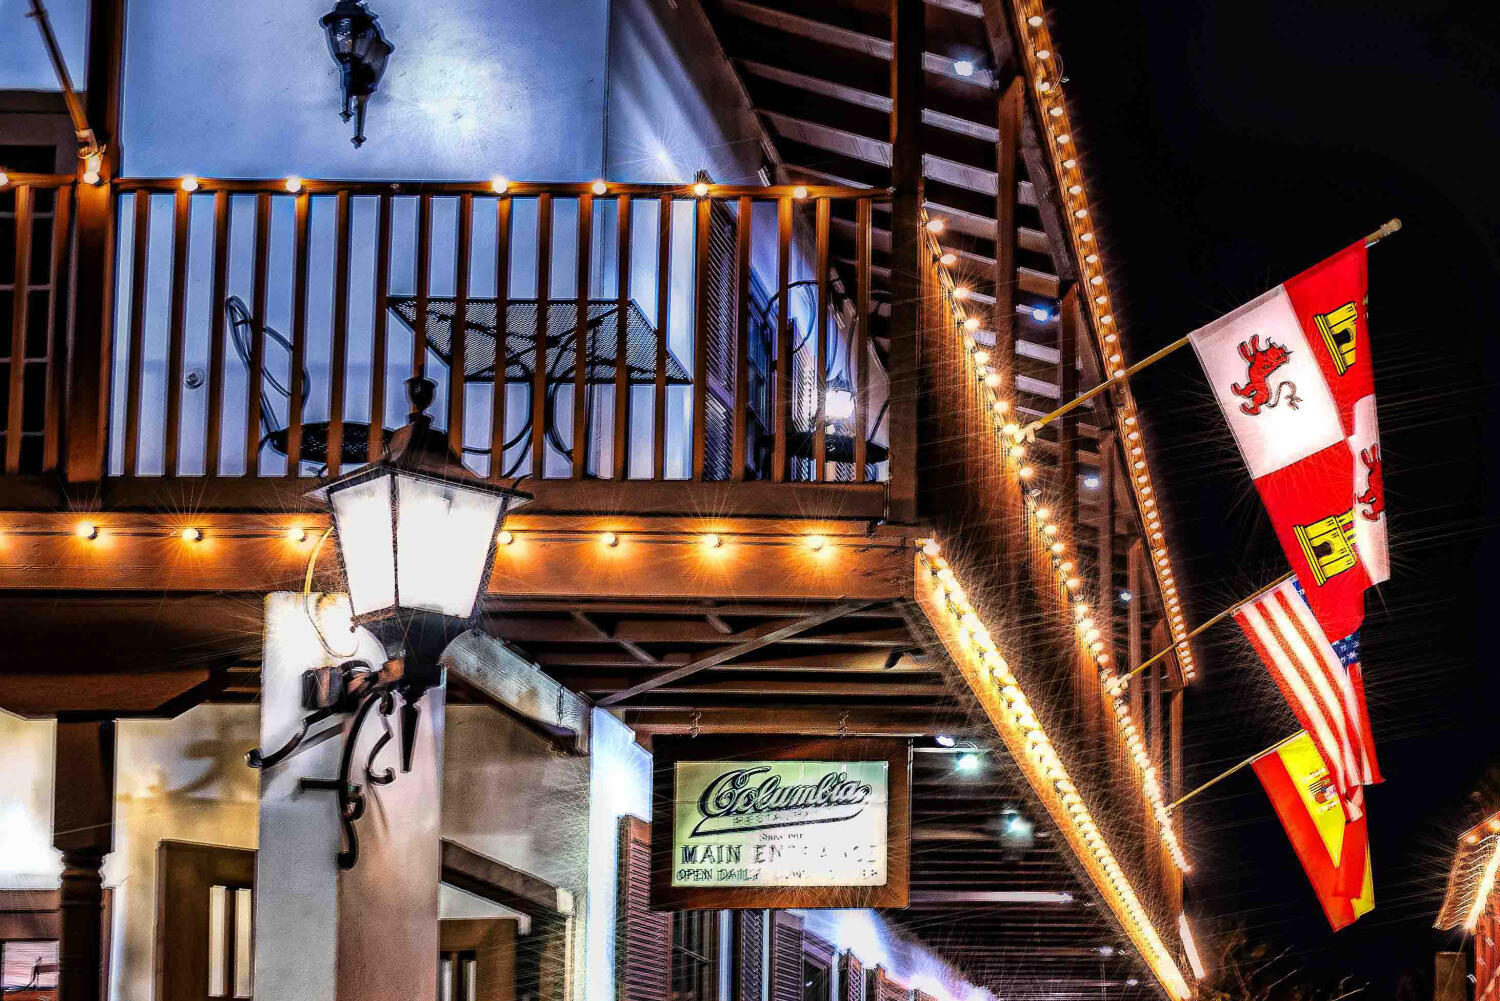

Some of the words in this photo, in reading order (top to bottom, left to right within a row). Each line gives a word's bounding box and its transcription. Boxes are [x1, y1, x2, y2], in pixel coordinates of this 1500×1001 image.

[697, 765, 872, 818] Columbia
[680, 845, 742, 864] MAIN
[676, 868, 713, 882] OPEN
[717, 868, 760, 882] DAILY
